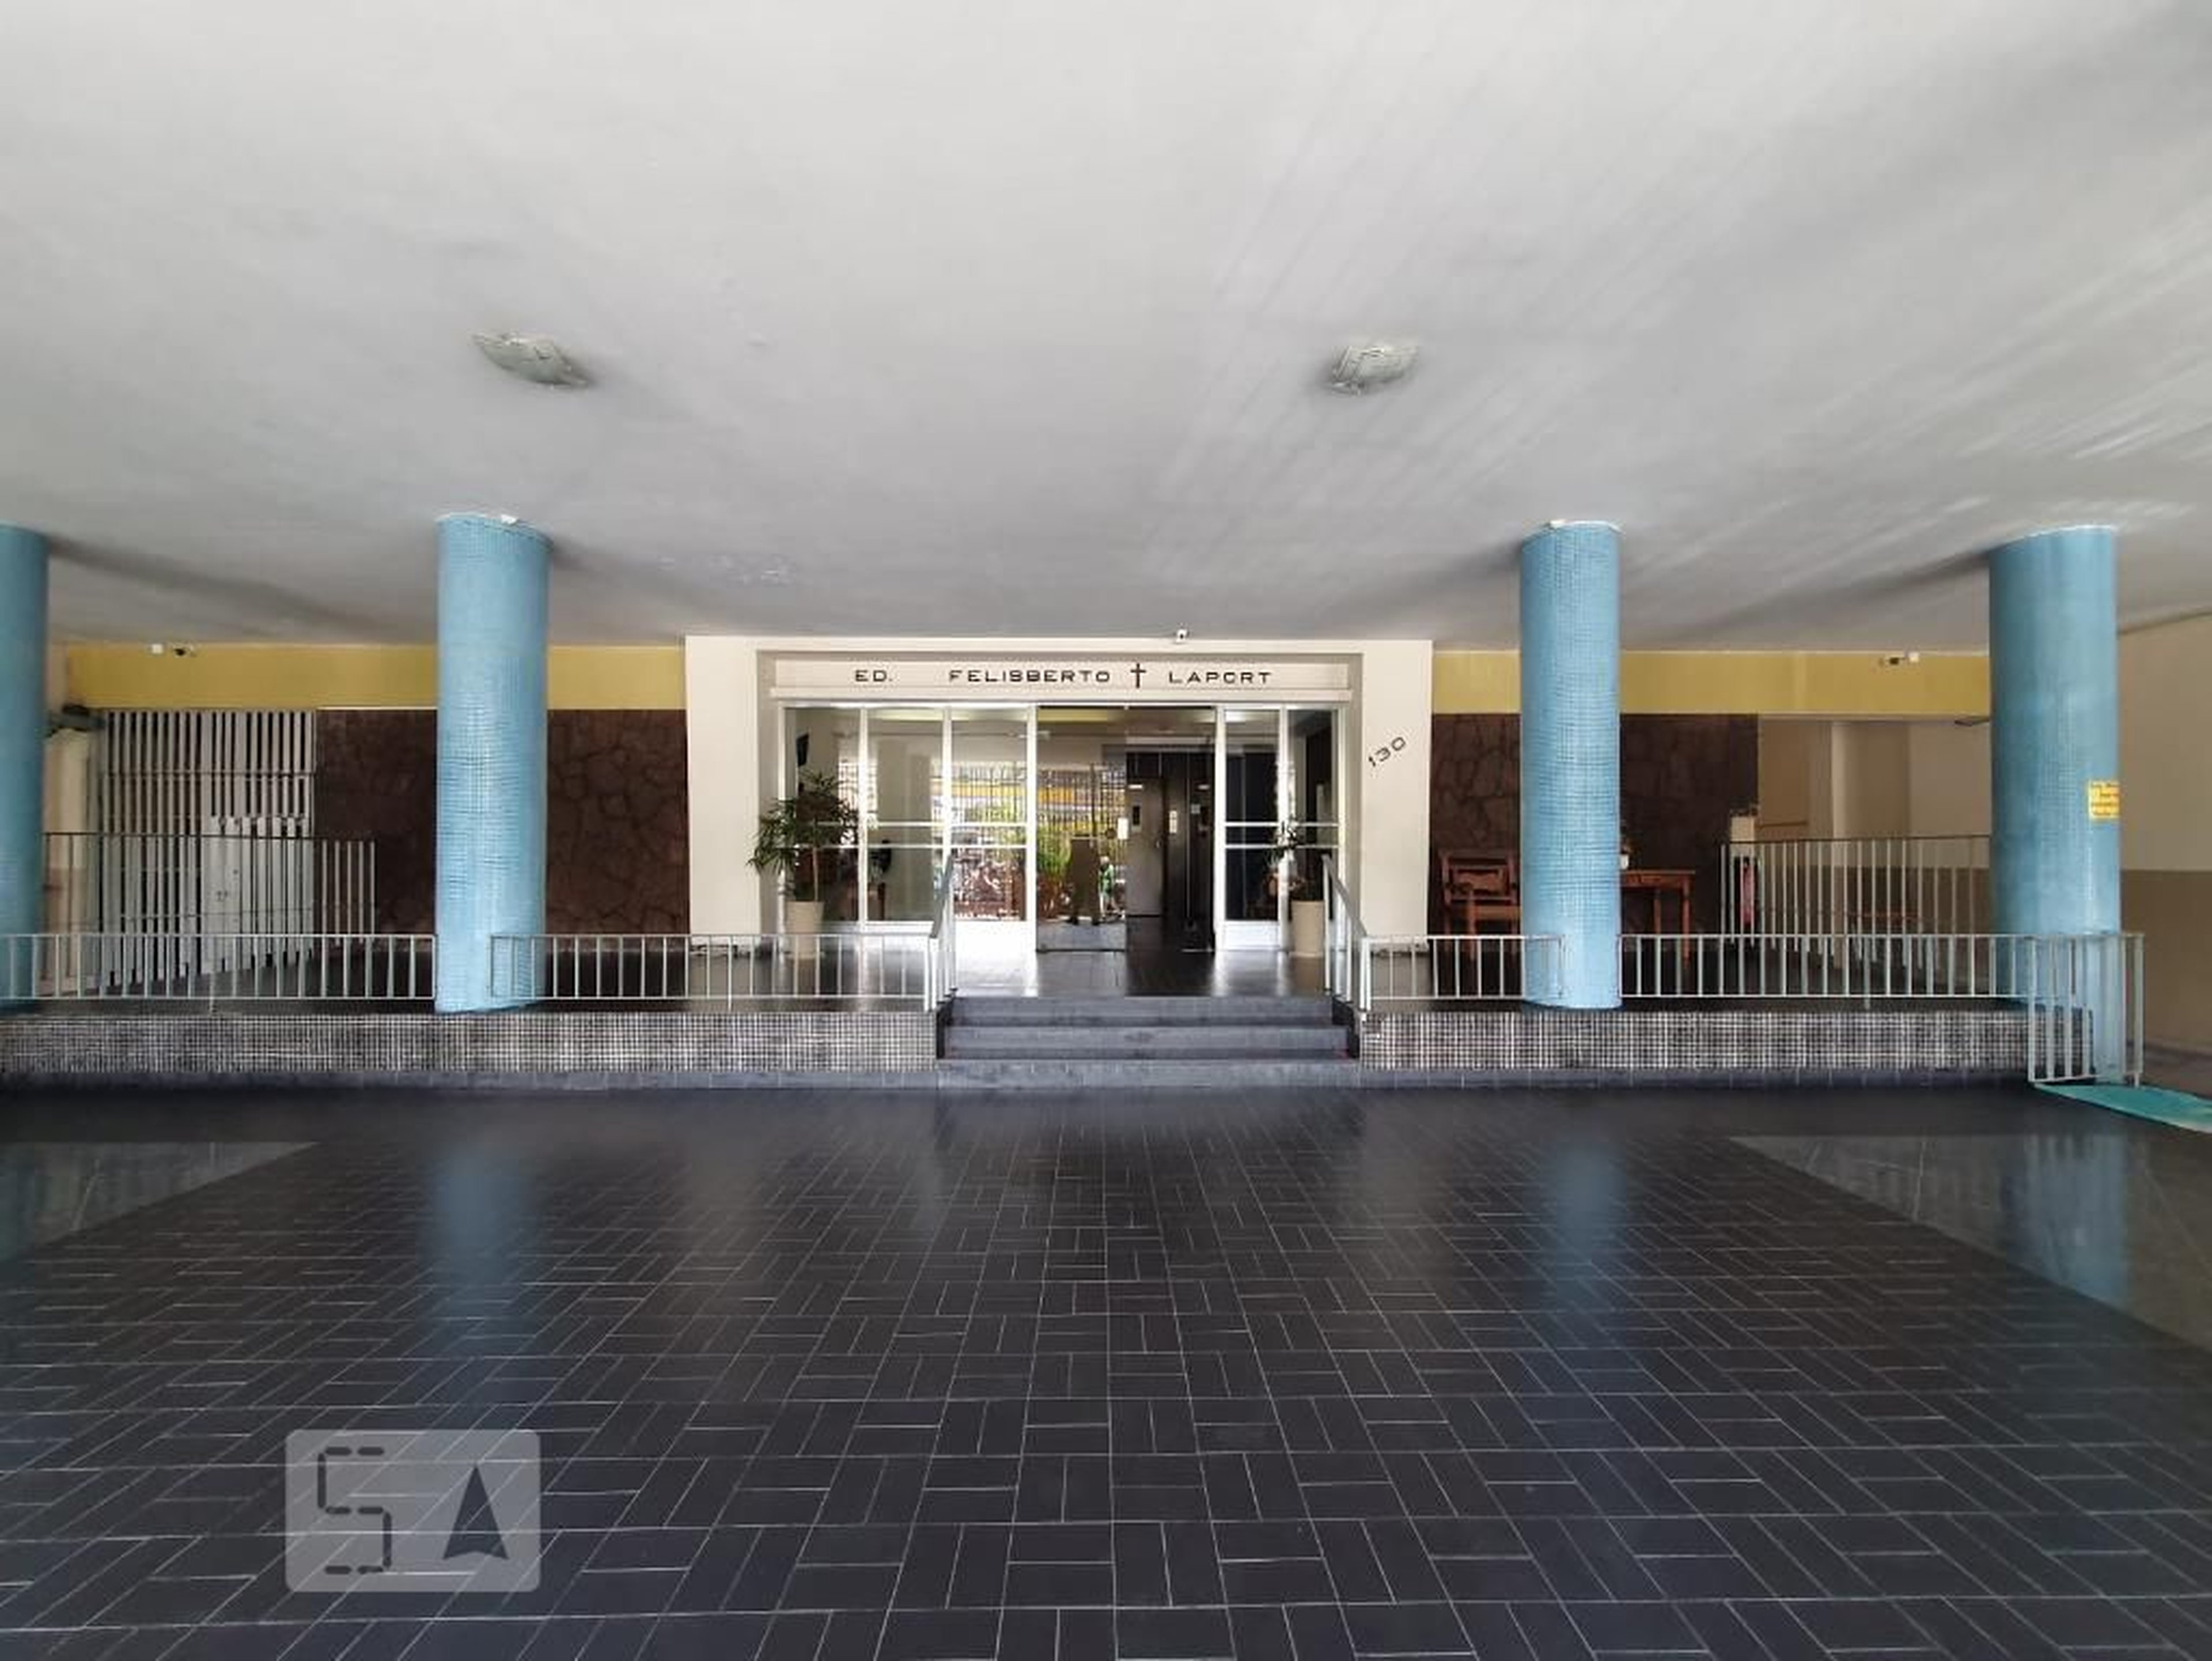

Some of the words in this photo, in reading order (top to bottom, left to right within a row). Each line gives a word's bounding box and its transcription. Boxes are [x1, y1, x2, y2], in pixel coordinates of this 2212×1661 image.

[855, 669, 893, 682] ED.
[949, 669, 1111, 682] FELISBERTO
[1368, 737, 1406, 767] 130
